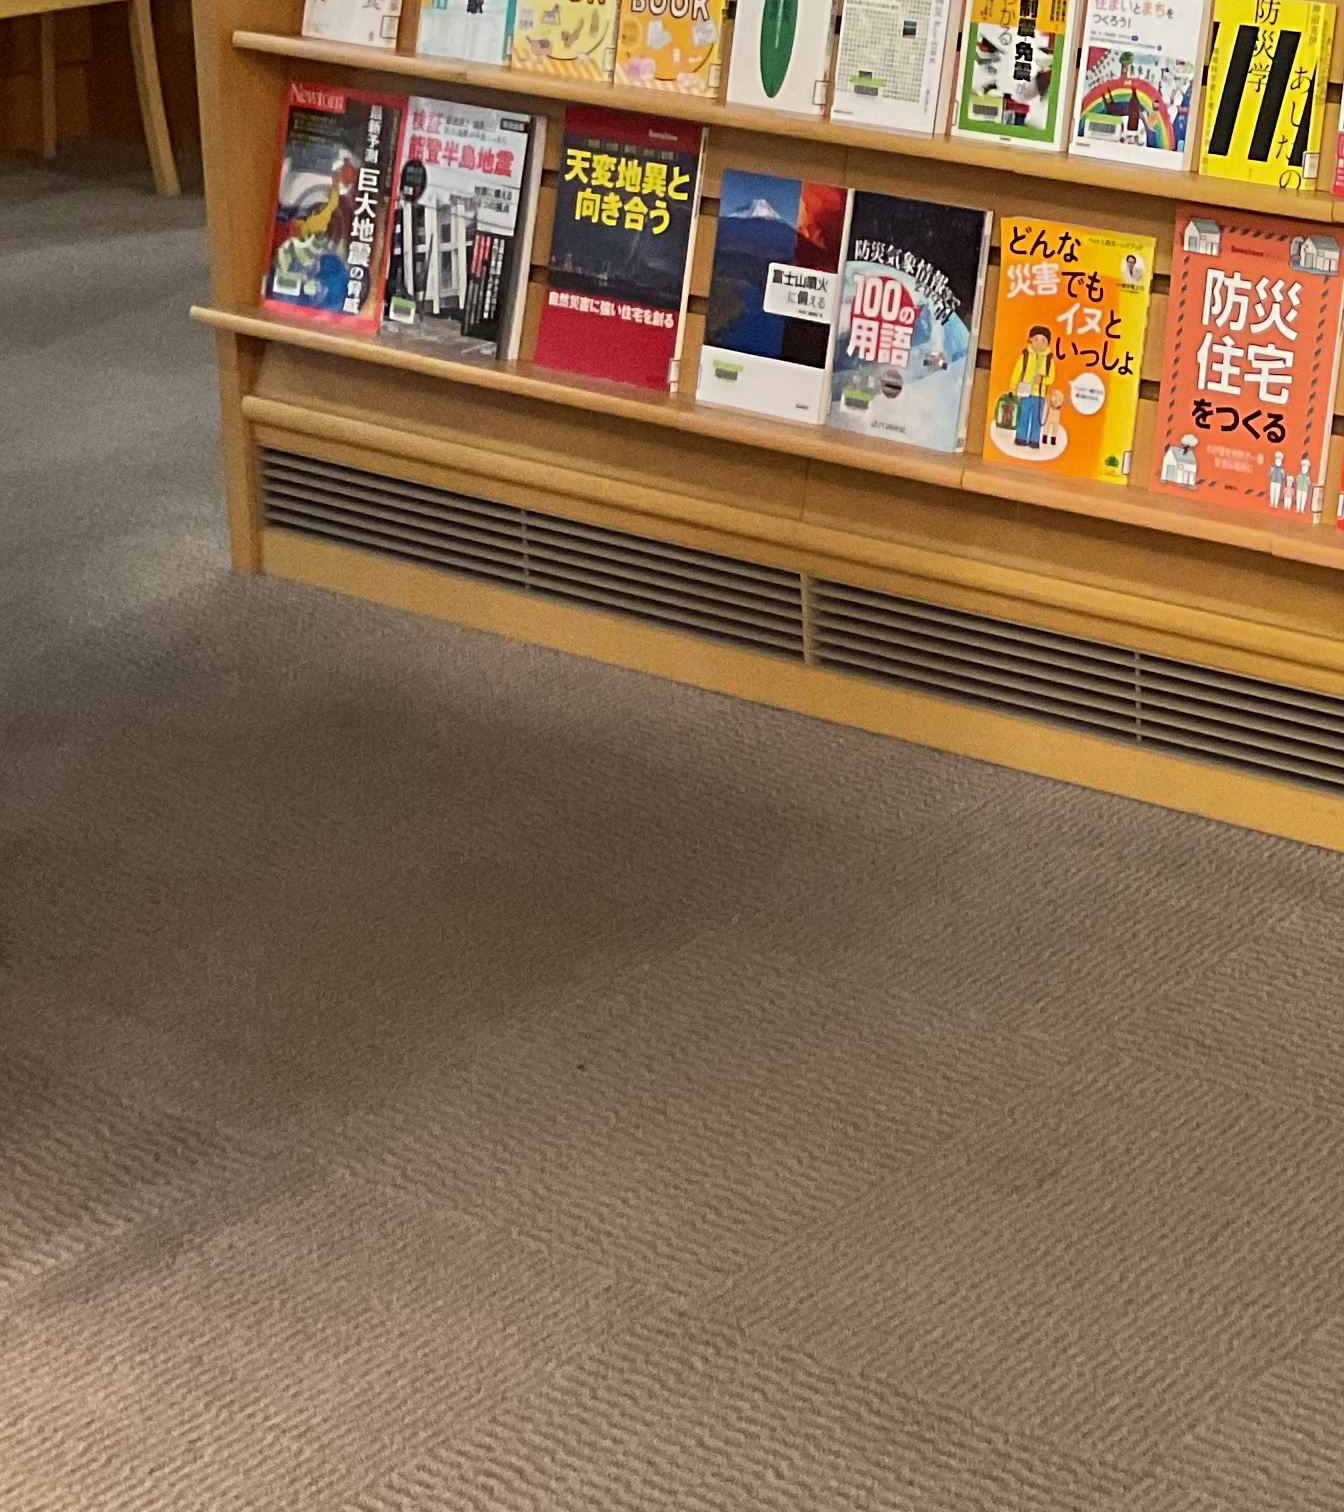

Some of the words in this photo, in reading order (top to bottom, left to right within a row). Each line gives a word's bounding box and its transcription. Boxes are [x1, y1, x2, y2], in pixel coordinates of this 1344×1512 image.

[411, 109, 443, 135] 検証
[407, 133, 515, 179] 能登半島地震
[563, 147, 692, 203] 天変地異と
[573, 190, 673, 236] 向き合う
[1008, 225, 1082, 264] どんな
[852, 273, 917, 325] 100の
[1006, 260, 1105, 304] 災害でも
[1200, 268, 1305, 342] 防災
[547, 290, 675, 330] 自然災害に強い住宅を創る
[1056, 301, 1123, 340] イヌと
[846, 316, 914, 369] 用語
[1054, 336, 1135, 377] いっしょ
[1194, 330, 1296, 407] 住宅
[1189, 397, 1288, 445] をつくる
